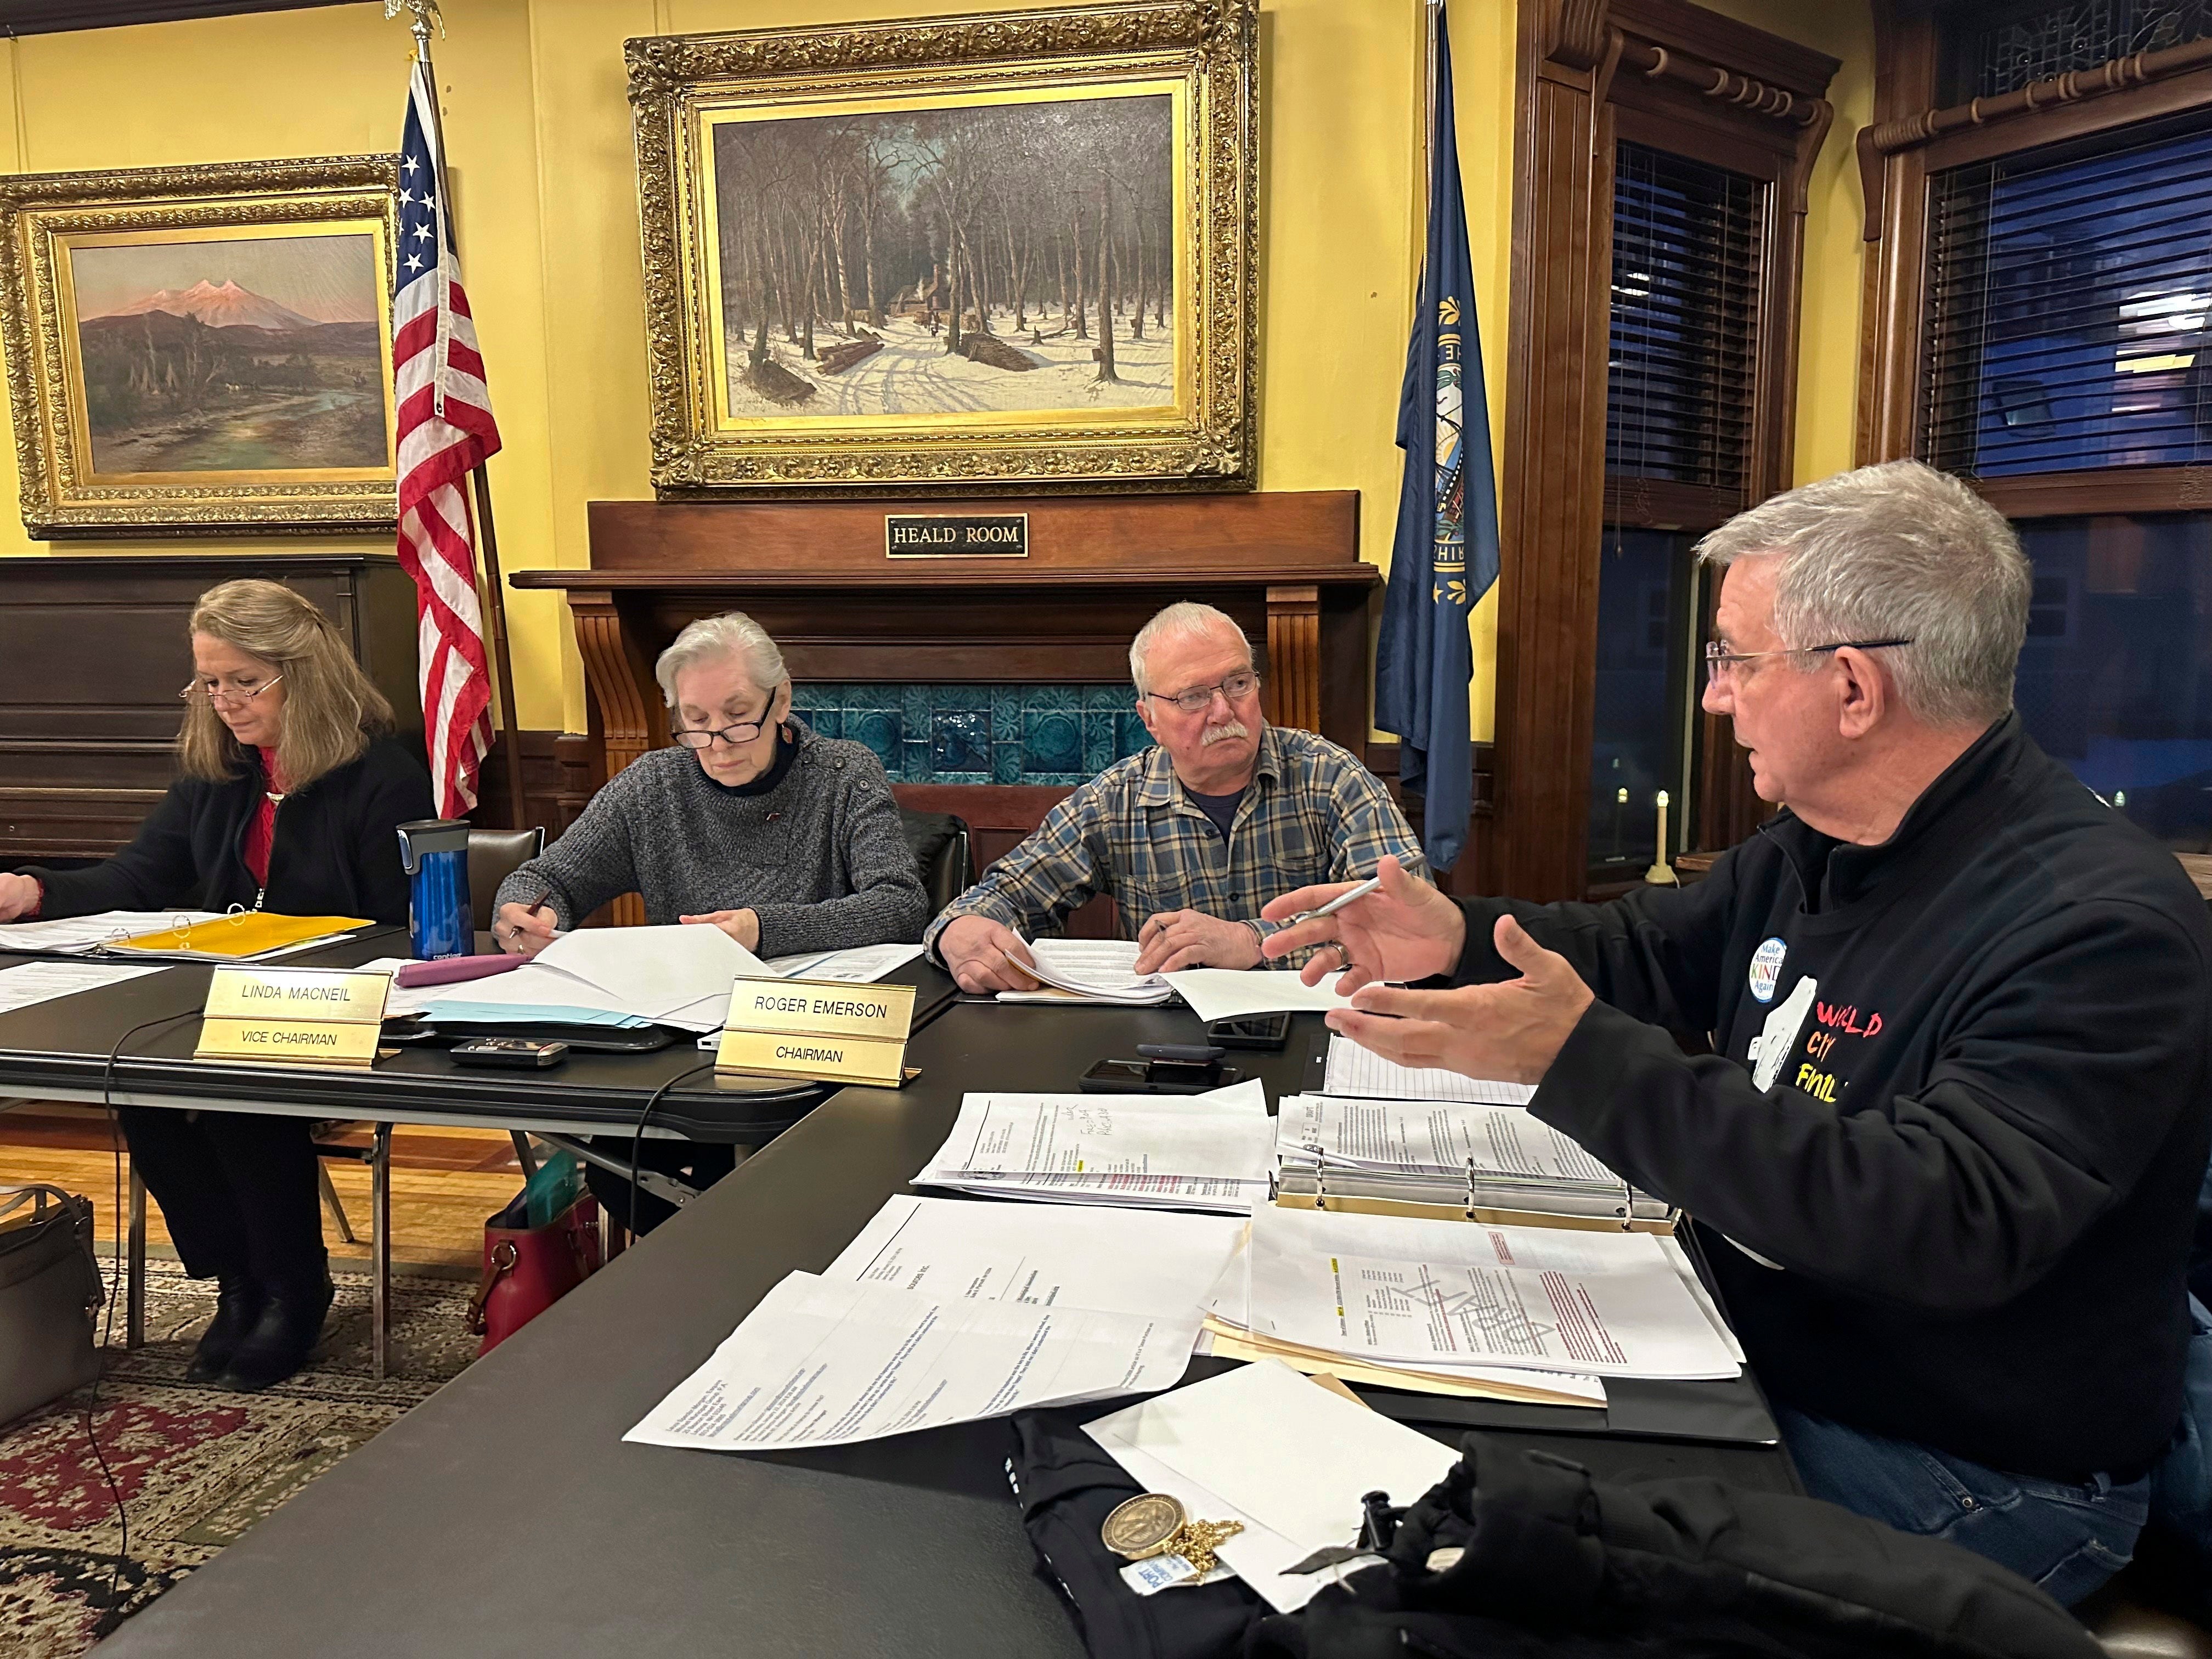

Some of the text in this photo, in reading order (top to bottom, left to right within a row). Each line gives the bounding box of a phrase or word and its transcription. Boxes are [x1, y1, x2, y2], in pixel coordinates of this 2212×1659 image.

[894, 527, 1018, 543] HEALD ROOM
[1761, 944, 1780, 955] Make
[1755, 953, 1783, 963] America
[1751, 963, 1781, 981] KIND
[242, 985, 351, 1001] LINDA MACNEIL
[1754, 980, 1773, 992] Again
[755, 996, 888, 1018] ROGER EMERSON
[241, 1030, 337, 1046] VICE CHAIRMAN
[776, 1046, 843, 1063] CHAIRMAN
[1392, 1280, 1555, 1343] DRAFT
[1138, 1568, 1163, 1589] PORT
